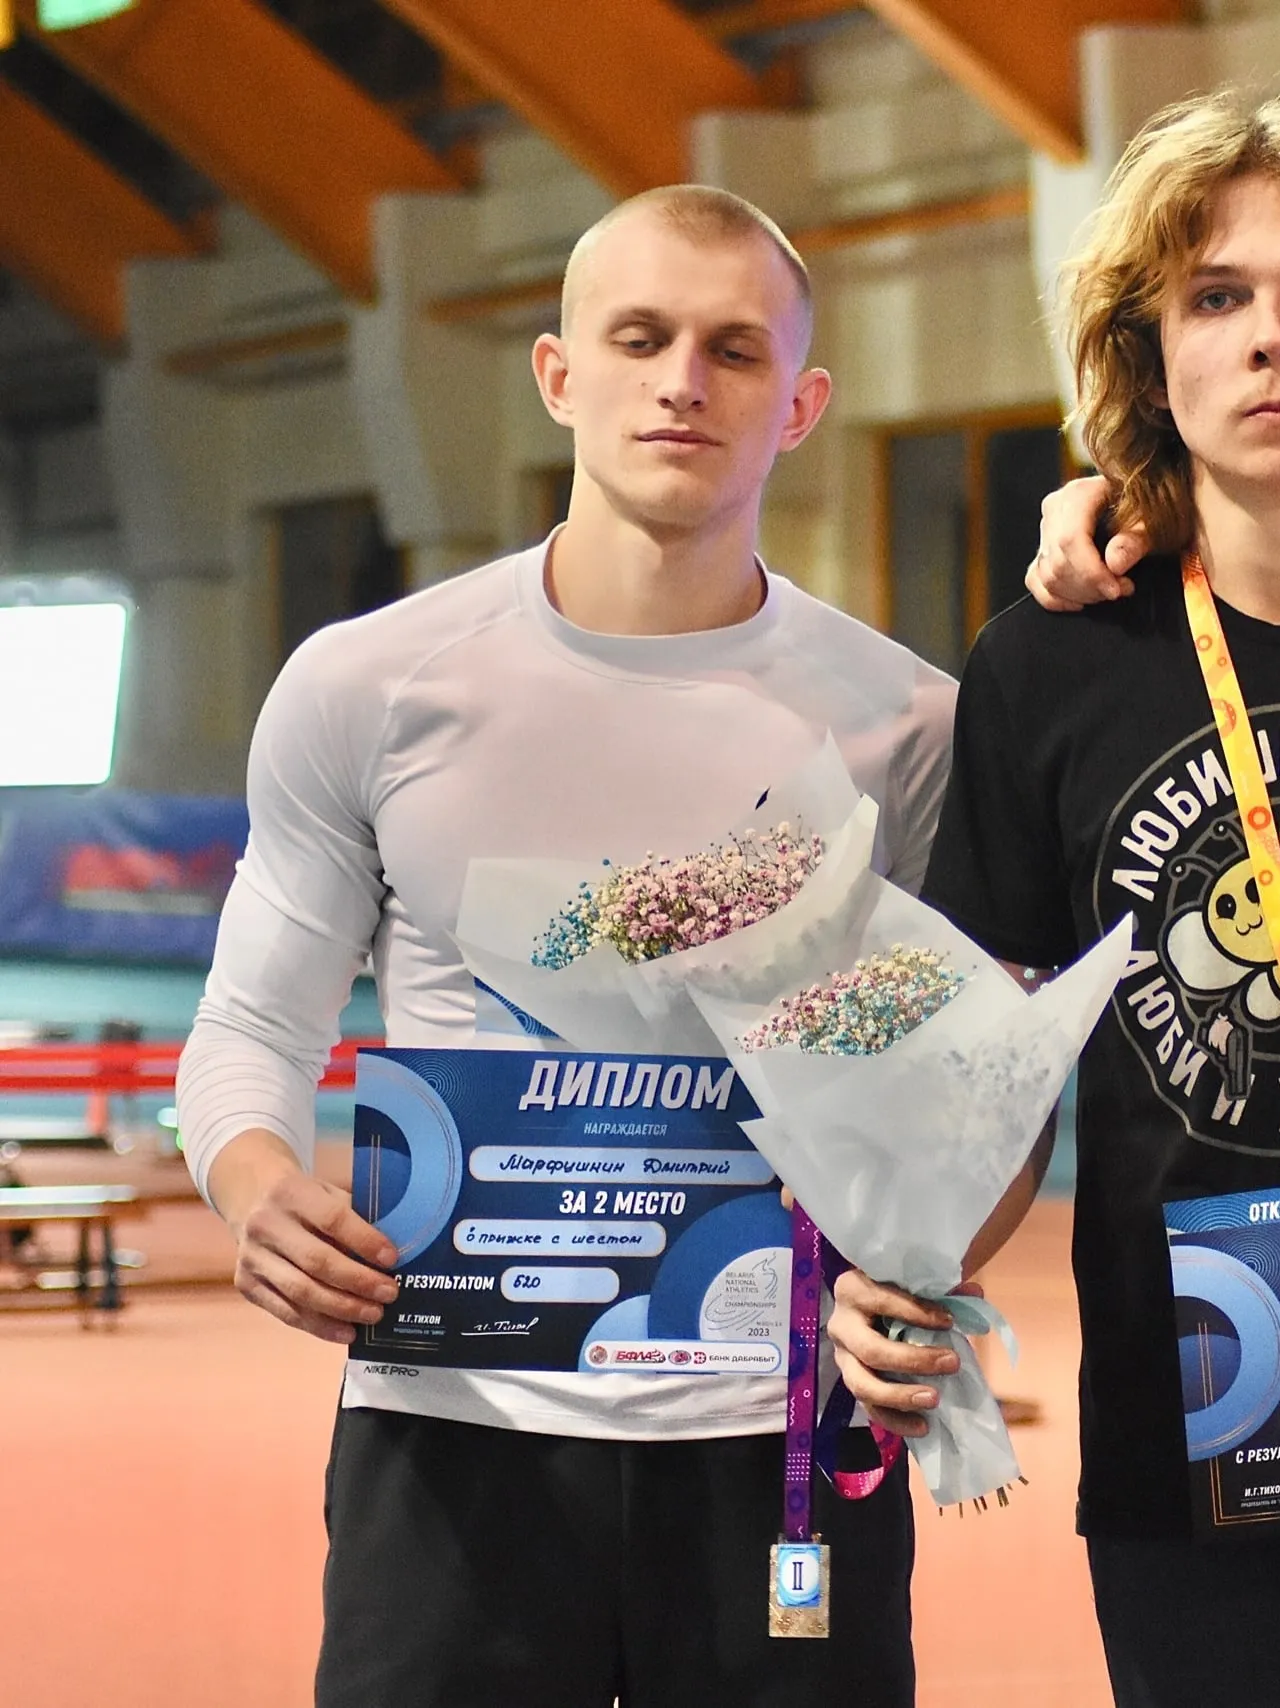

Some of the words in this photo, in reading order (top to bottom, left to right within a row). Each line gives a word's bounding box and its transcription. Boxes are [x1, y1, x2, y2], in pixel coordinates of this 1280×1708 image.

[518, 1059, 736, 1112] ДИПЛОМ
[583, 1122, 668, 1136] НАГРАЖДАЕТСЯ
[643, 1158, 731, 1174] Дмитрий
[559, 1190, 586, 1214] ЗА
[592, 1191, 606, 1214] 2
[613, 1191, 687, 1215] МЕСТО
[572, 1234, 642, 1245] шестом
[405, 1274, 495, 1291] РЕЗУЛЬТАТОМ
[398, 1313, 441, 1325] И.Г.ТИХОН
[747, 1327, 770, 1337] 2023
[731, 1355, 776, 1363] ДАБРАБЫТ
[1235, 1450, 1244, 1464] С
[791, 1561, 804, 1591] II
